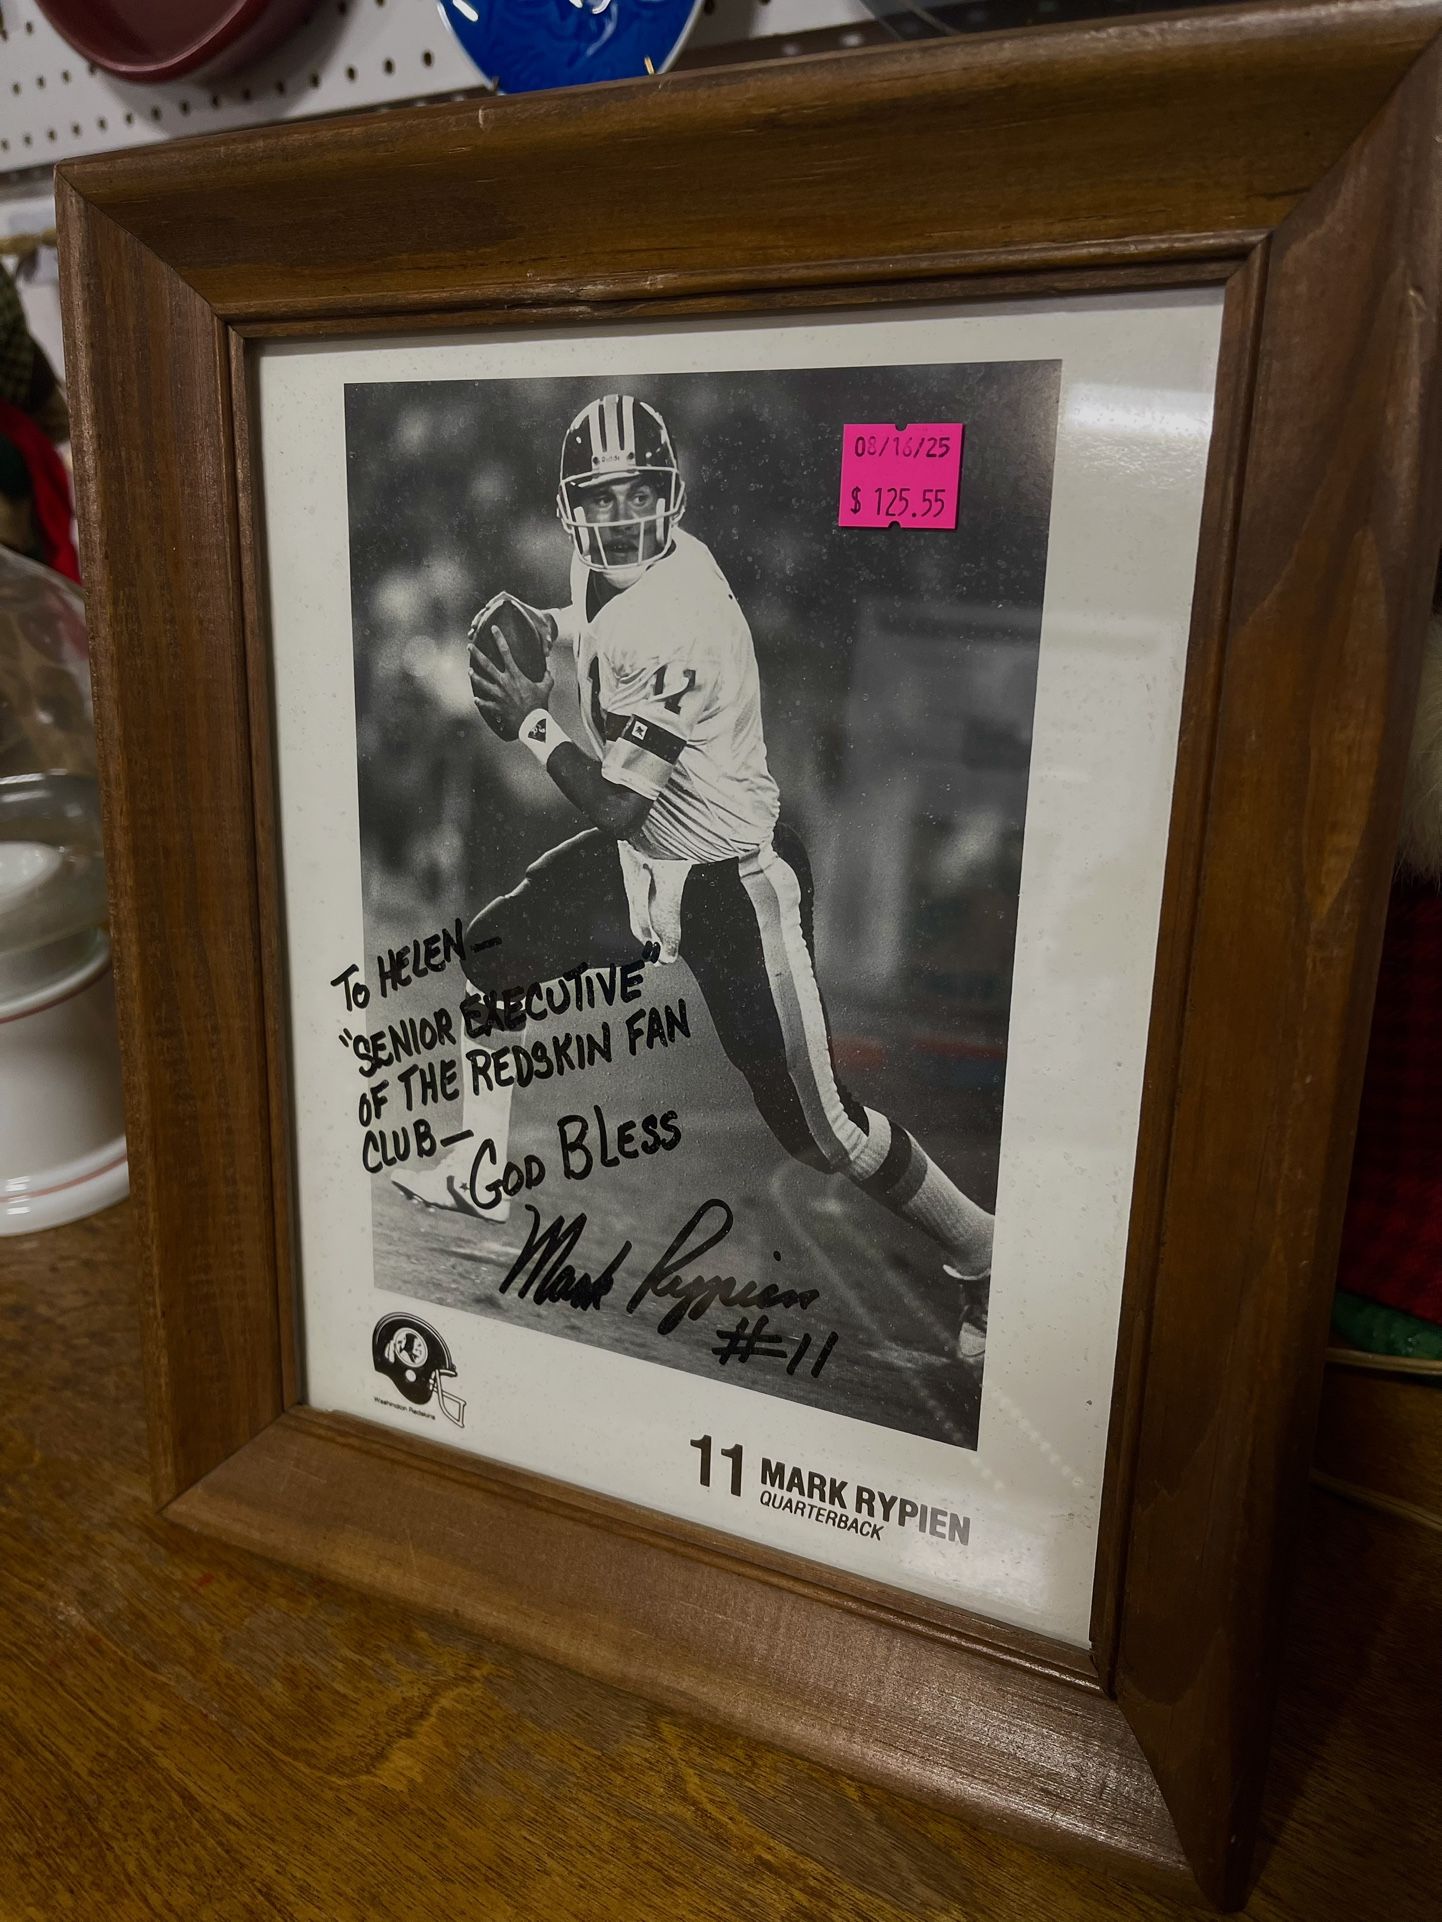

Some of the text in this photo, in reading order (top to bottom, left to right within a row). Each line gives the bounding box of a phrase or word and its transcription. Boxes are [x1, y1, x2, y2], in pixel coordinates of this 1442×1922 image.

[850, 486, 946, 518] $ 125.55
[358, 998, 692, 1127] OF THE REDSKIN FAN
[711, 1314, 839, 1379] #11
[690, 1434, 743, 1497] 11
[759, 1490, 885, 1541] QUARTERBACK
[760, 1457, 971, 1546] MARK RYPIEN
